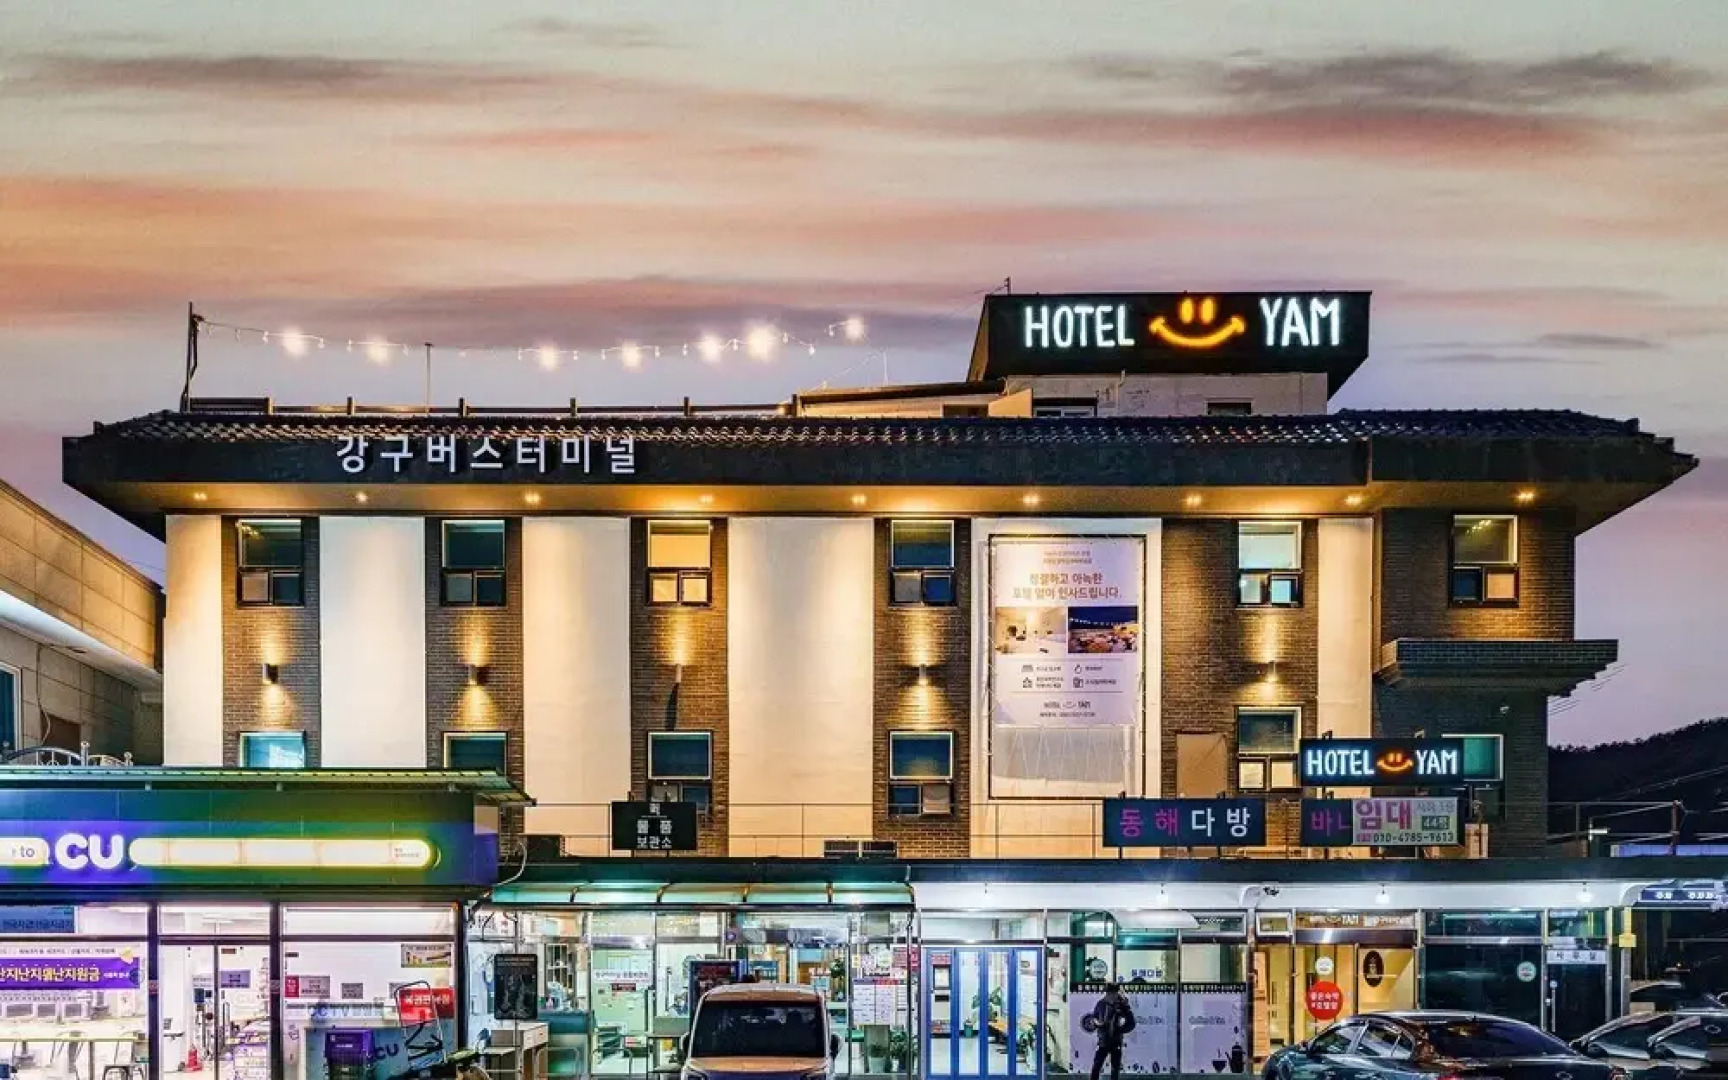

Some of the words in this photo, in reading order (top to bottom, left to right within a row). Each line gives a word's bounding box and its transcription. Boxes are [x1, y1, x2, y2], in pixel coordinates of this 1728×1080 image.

[1023, 304, 1135, 348] HOTEL
[1259, 297, 1341, 347] YAM
[336, 434, 637, 475] 강구버스터미널
[1306, 749, 1375, 776] HOTEL
[1415, 749, 1458, 775] YAM
[1119, 807, 1251, 838] 동해다방
[1355, 800, 1412, 831] 임대
[55, 832, 125, 870] CU
[637, 836, 673, 849] 보관소
